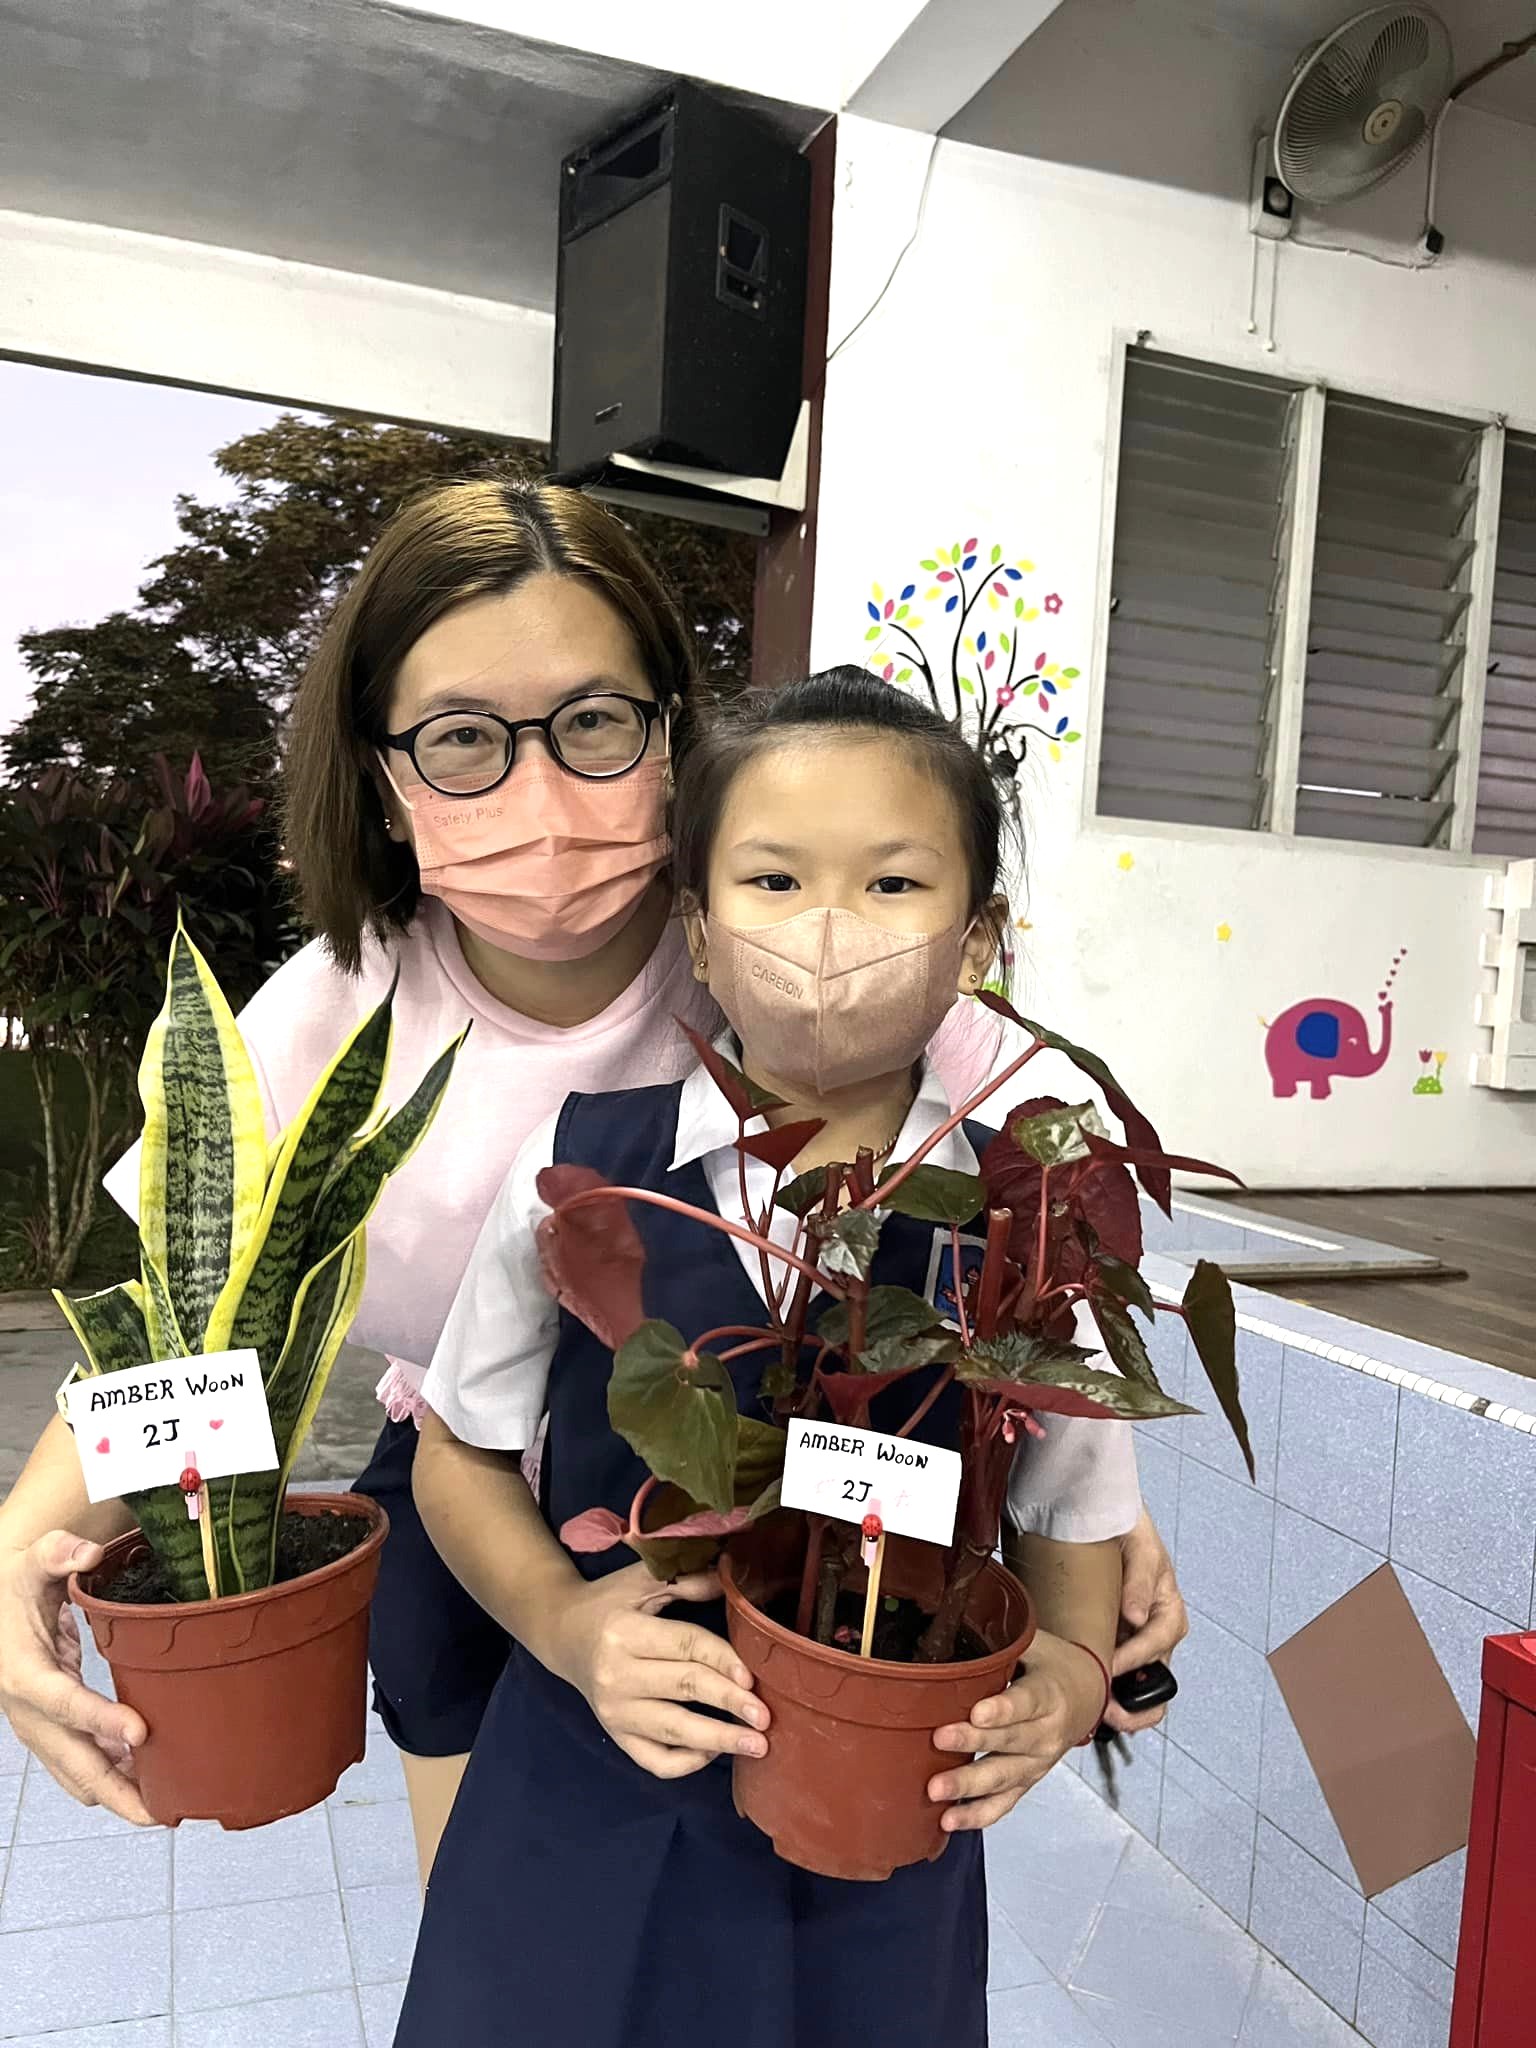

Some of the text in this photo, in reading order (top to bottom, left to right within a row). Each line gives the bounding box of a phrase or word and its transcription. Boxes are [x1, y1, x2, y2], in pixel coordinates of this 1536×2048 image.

[476, 807, 504, 820] Plus
[90, 1378, 175, 1412] AMBER
[143, 1418, 180, 1448] 2J
[799, 1431, 865, 1457] AMBER
[841, 1479, 873, 1502] 2J
